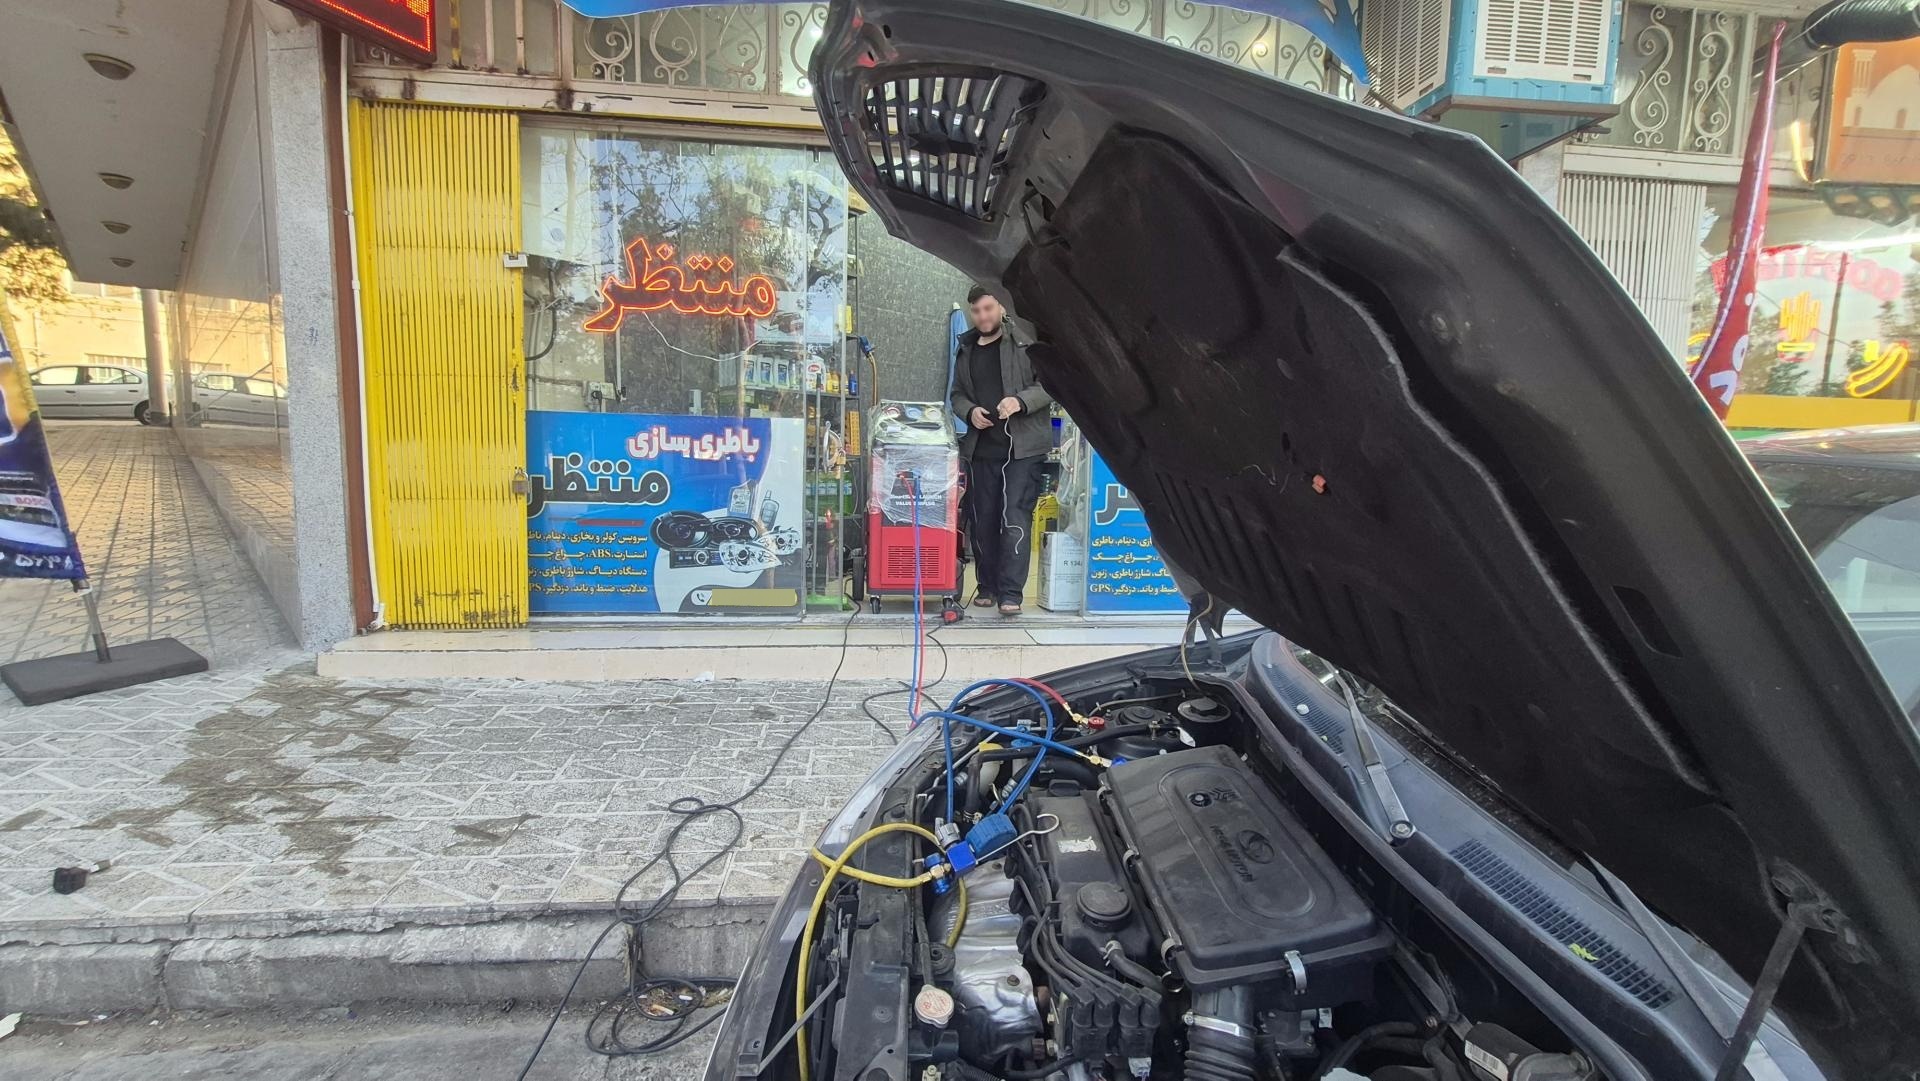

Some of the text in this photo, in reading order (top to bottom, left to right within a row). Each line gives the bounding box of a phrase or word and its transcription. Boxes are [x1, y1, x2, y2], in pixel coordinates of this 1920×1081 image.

[583, 237, 776, 332] منتظر
[693, 427, 760, 463] باطری
[527, 452, 670, 519] منتظر
[528, 530, 542, 542] باط
[601, 531, 618, 544] کولر
[618, 535, 648, 544] سرویس
[528, 583, 542, 592] PS
[1089, 583, 1111, 593] GPS
